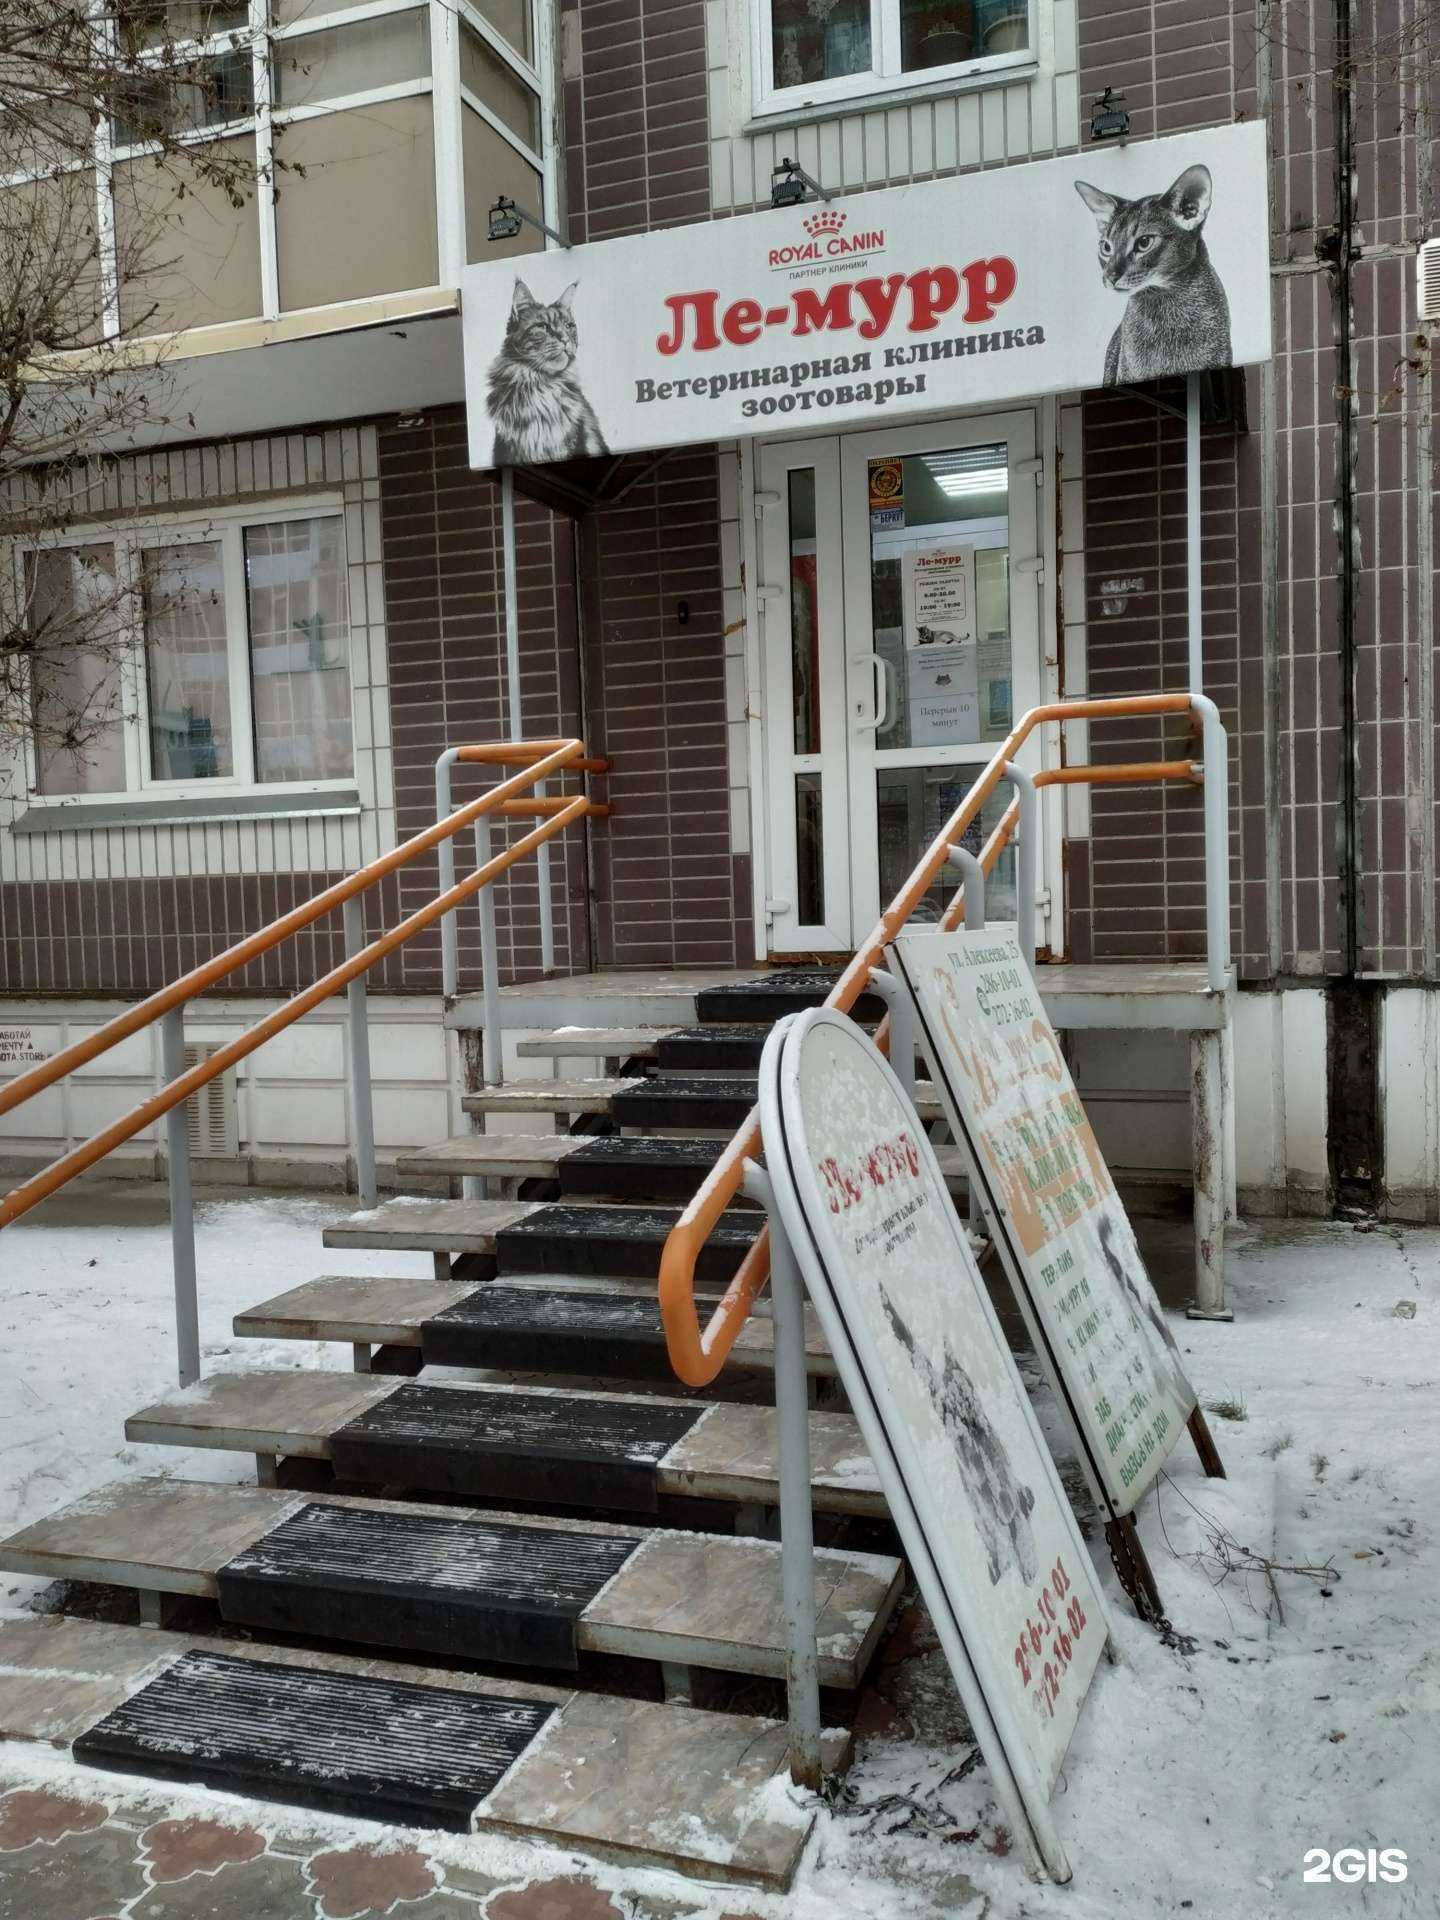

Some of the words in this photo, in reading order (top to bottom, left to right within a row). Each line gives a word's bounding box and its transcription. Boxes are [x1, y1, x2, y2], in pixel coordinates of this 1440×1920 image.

[769, 243, 823, 266] ROYAL
[827, 229, 885, 255] CANIN
[789, 267, 828, 280] ПАРТНЕР
[829, 260, 868, 273] КЛИНИКИ
[656, 255, 1018, 357] Ле-мурр
[635, 351, 872, 403] Ветеринарная
[884, 325, 1045, 368] клиника
[741, 374, 927, 417] зоотовары
[980, 968, 1022, 993] 286-10-01
[991, 998, 1034, 1025] 272-16-02
